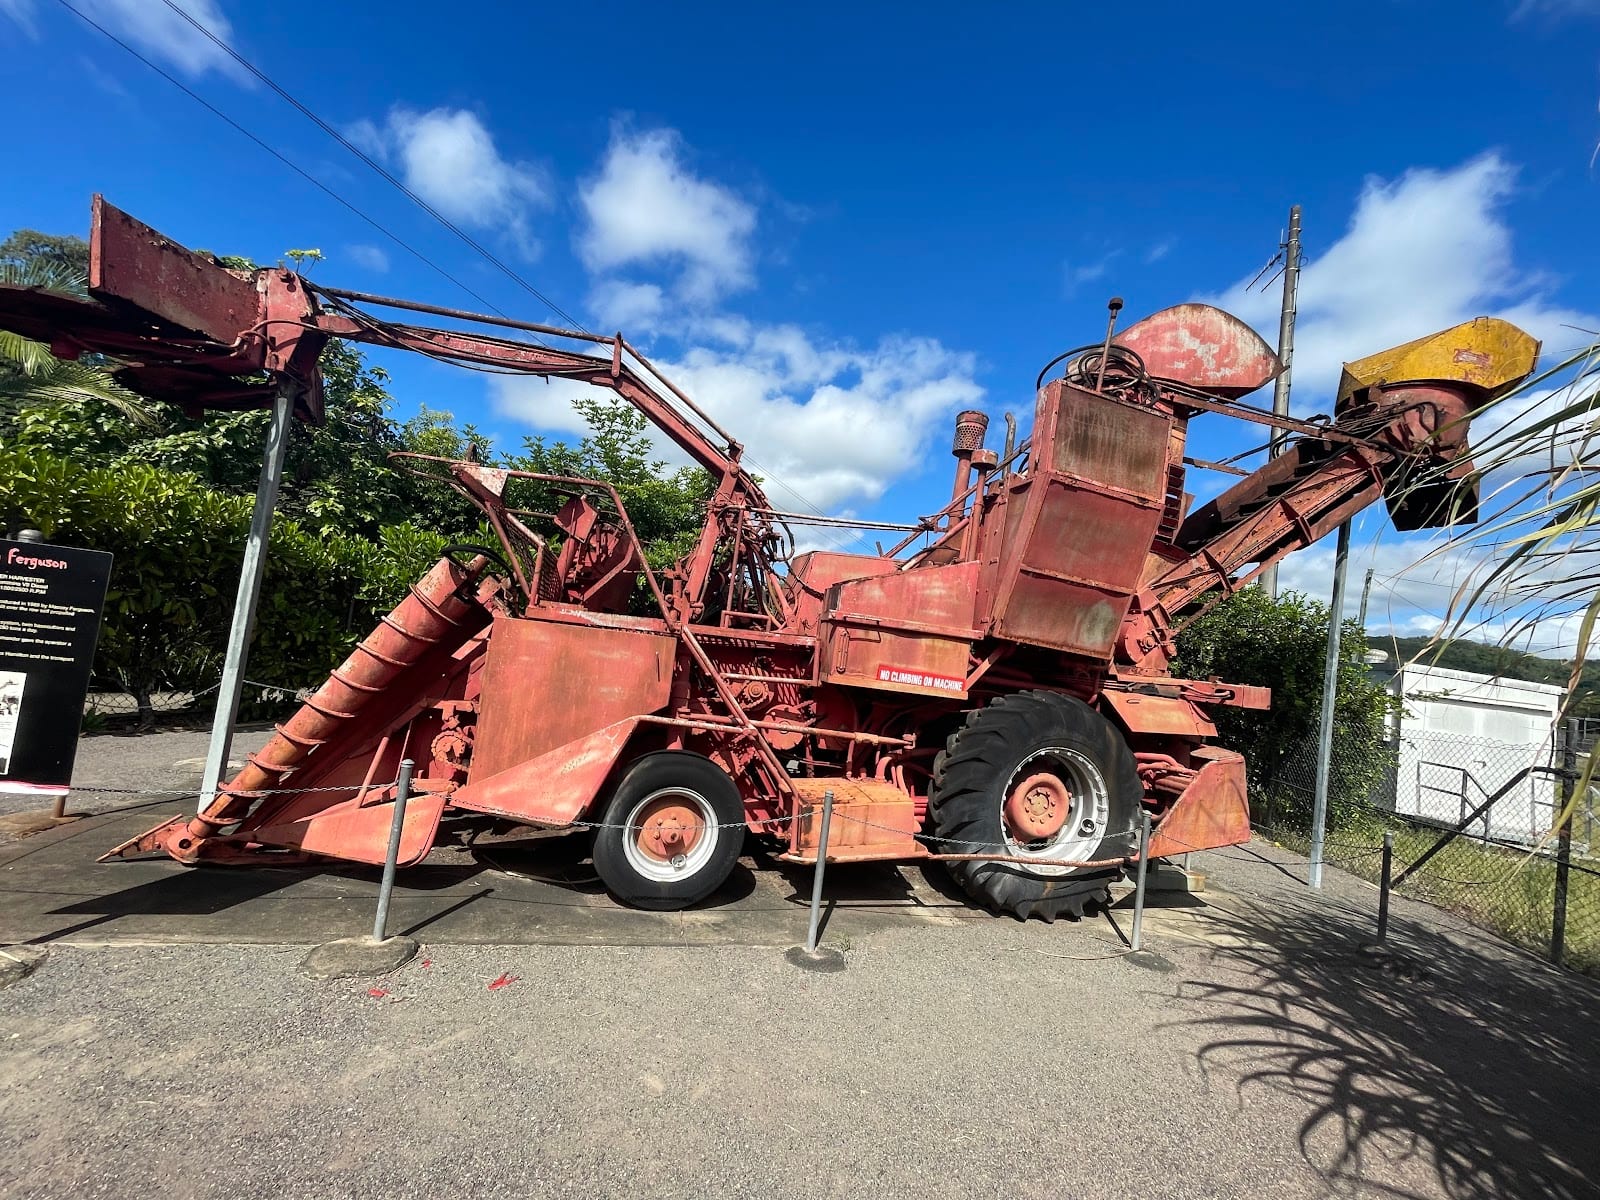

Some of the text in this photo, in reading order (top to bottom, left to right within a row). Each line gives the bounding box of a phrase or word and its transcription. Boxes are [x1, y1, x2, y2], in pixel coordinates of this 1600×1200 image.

[880, 669, 964, 692] NO CLIMBING ON MACHINE
